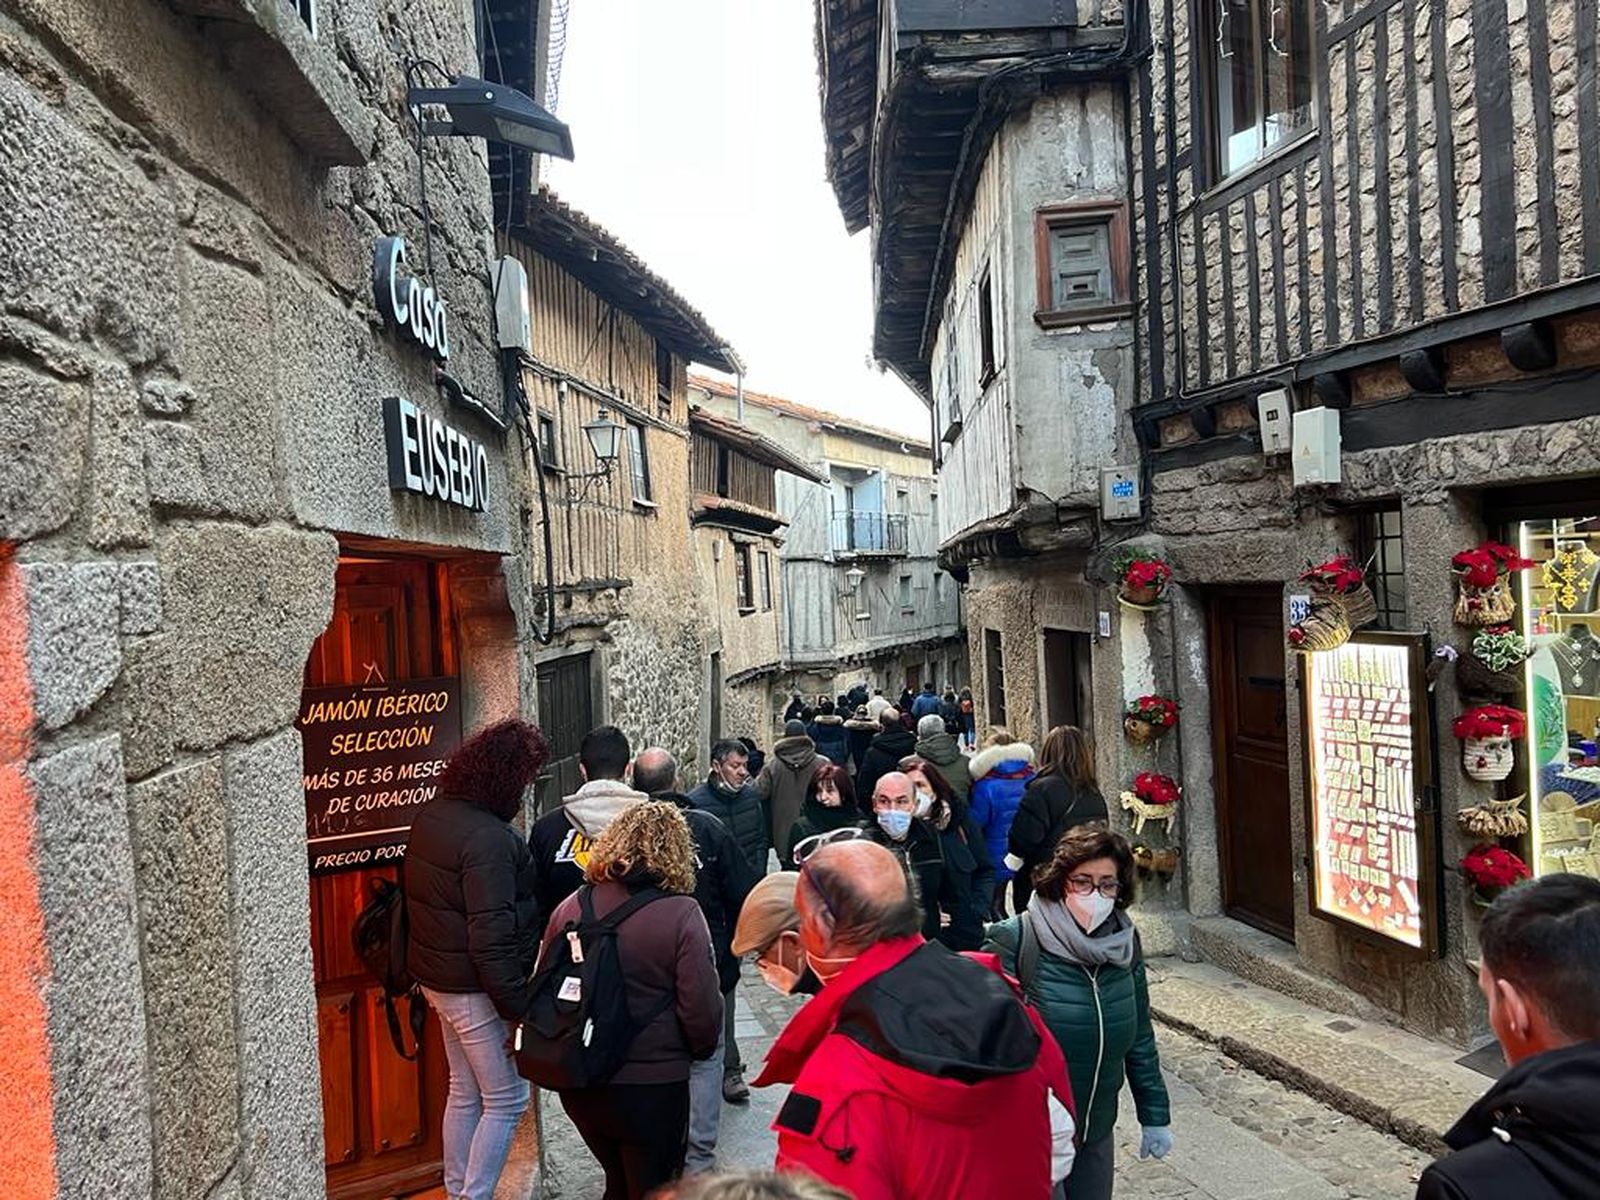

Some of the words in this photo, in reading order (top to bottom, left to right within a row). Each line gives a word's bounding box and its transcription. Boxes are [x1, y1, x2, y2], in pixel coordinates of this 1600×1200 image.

[388, 236, 449, 361] Casa
[399, 399, 490, 512] EUSEBIO
[302, 692, 372, 725] JAMÓN
[375, 688, 448, 717] IBÉRICO
[331, 720, 434, 755] SELECCIÓN
[303, 767, 339, 790] MÁS
[344, 769, 367, 787] DE
[371, 766, 393, 784] 36
[328, 797, 351, 814] DE
[354, 782, 437, 812] CURACIÓN
[315, 849, 371, 869] PRECIO
[374, 844, 407, 860] POR
